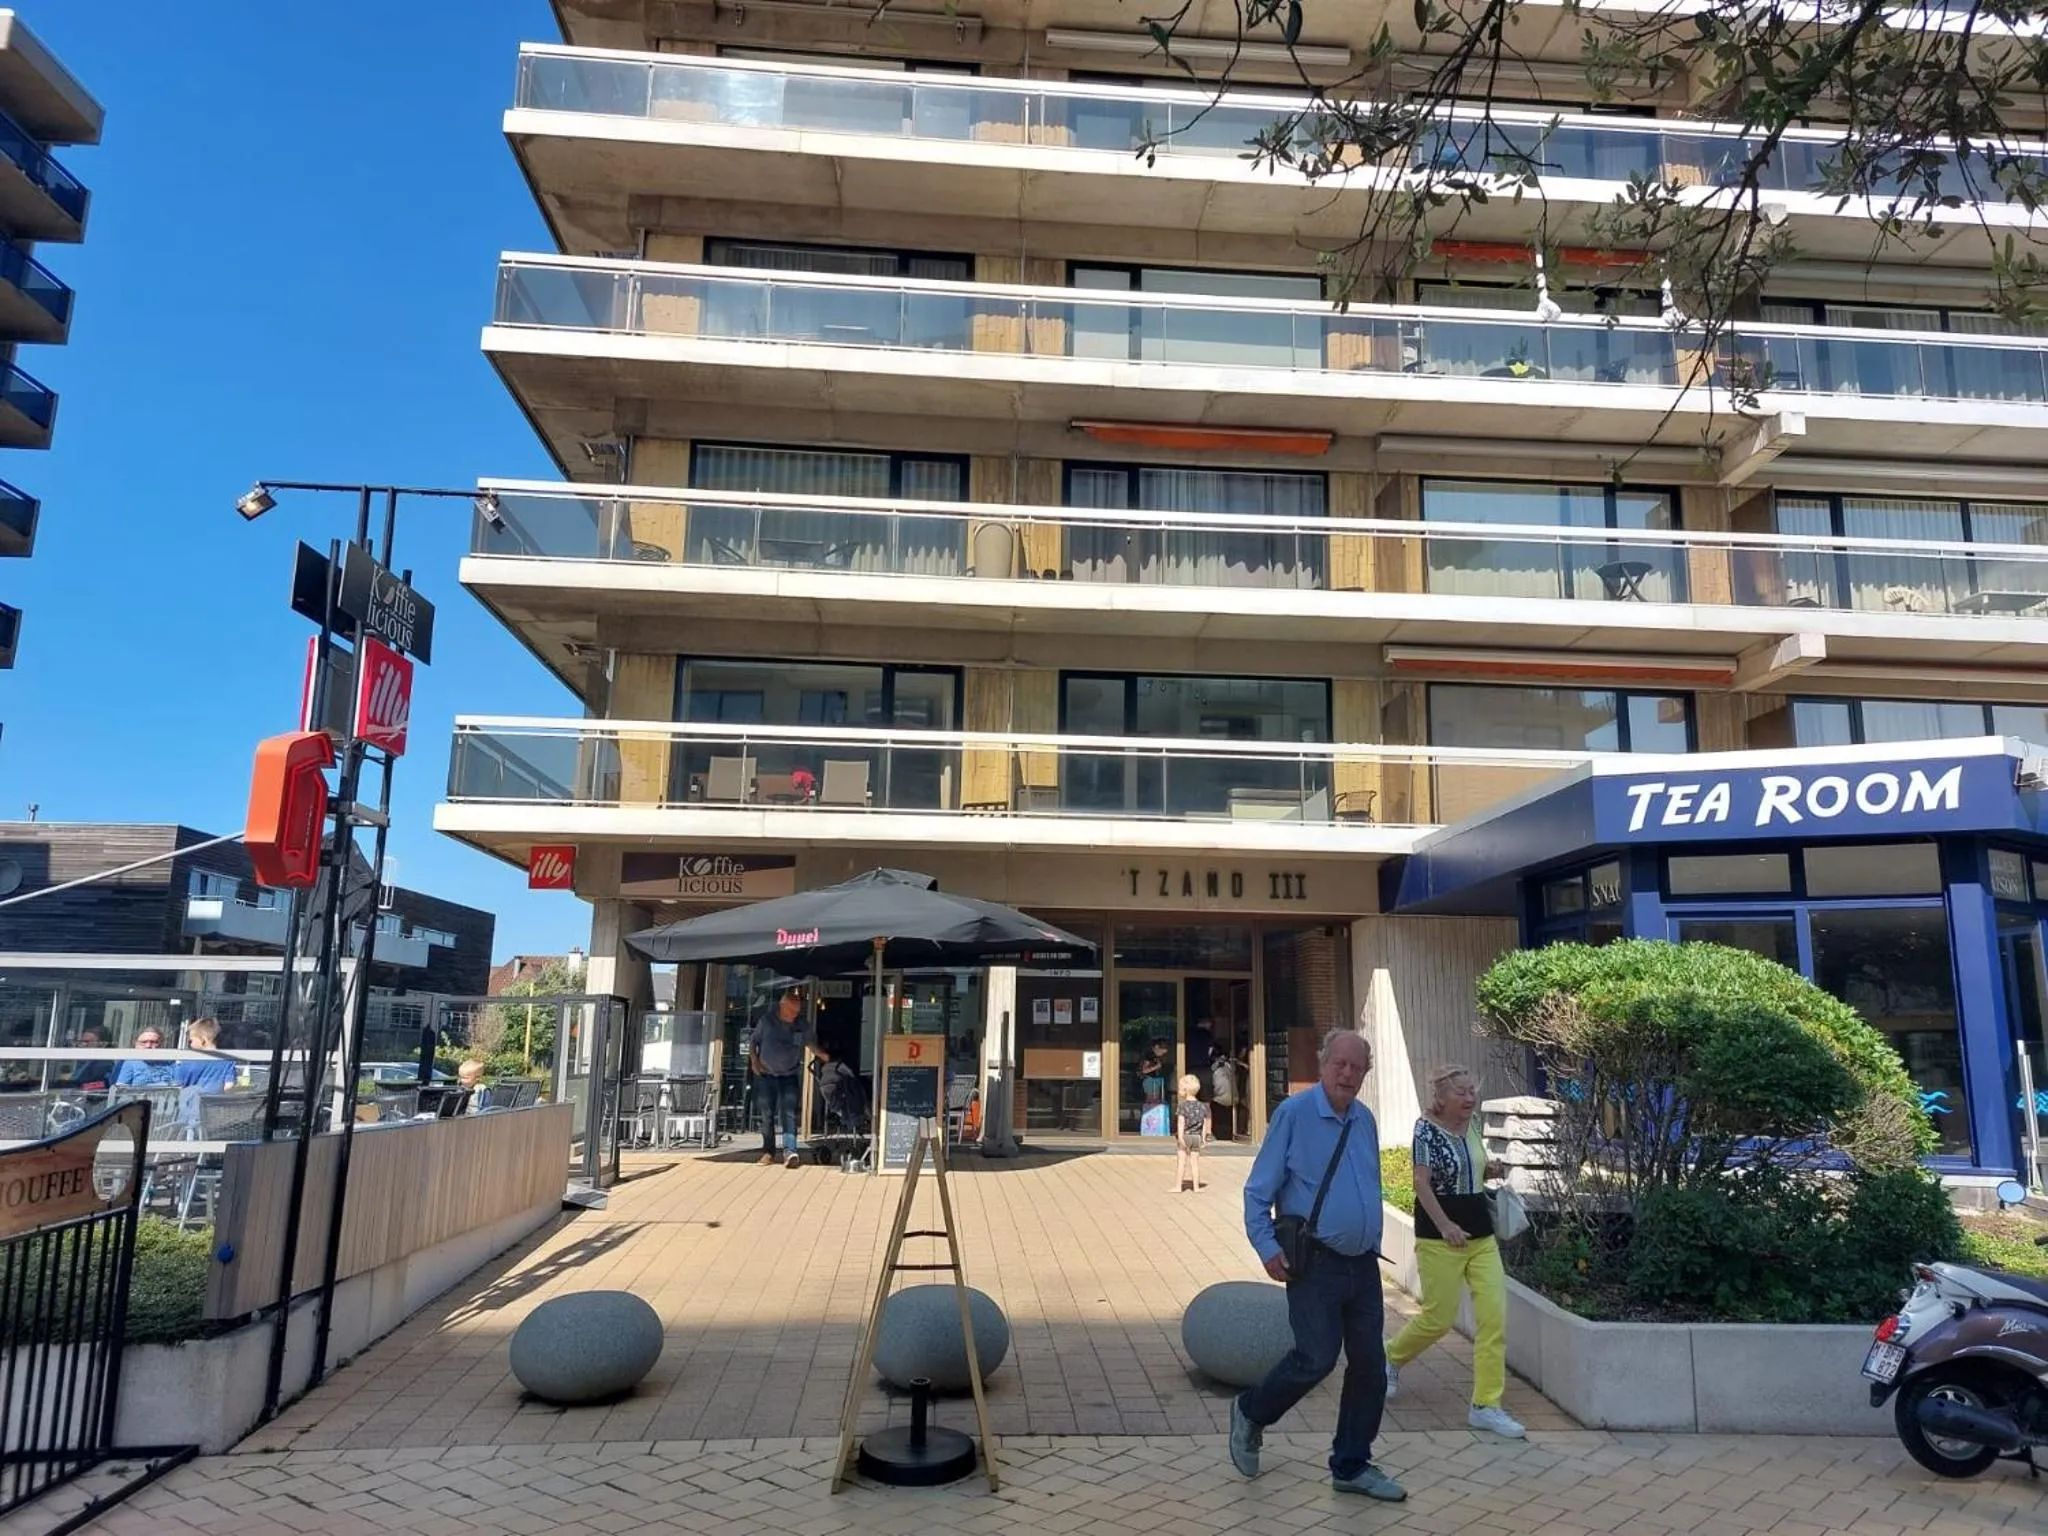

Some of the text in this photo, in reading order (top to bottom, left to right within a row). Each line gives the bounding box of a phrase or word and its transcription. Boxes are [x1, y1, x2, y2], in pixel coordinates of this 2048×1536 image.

[367, 592, 413, 651] licious
[369, 661, 408, 741] illy
[1627, 765, 1963, 833] TEA ROOM
[532, 852, 571, 885] illy
[677, 875, 743, 894] licious
[1158, 869, 1243, 899] ZANO
[1269, 872, 1307, 900] III
[776, 928, 819, 945] Duvel
